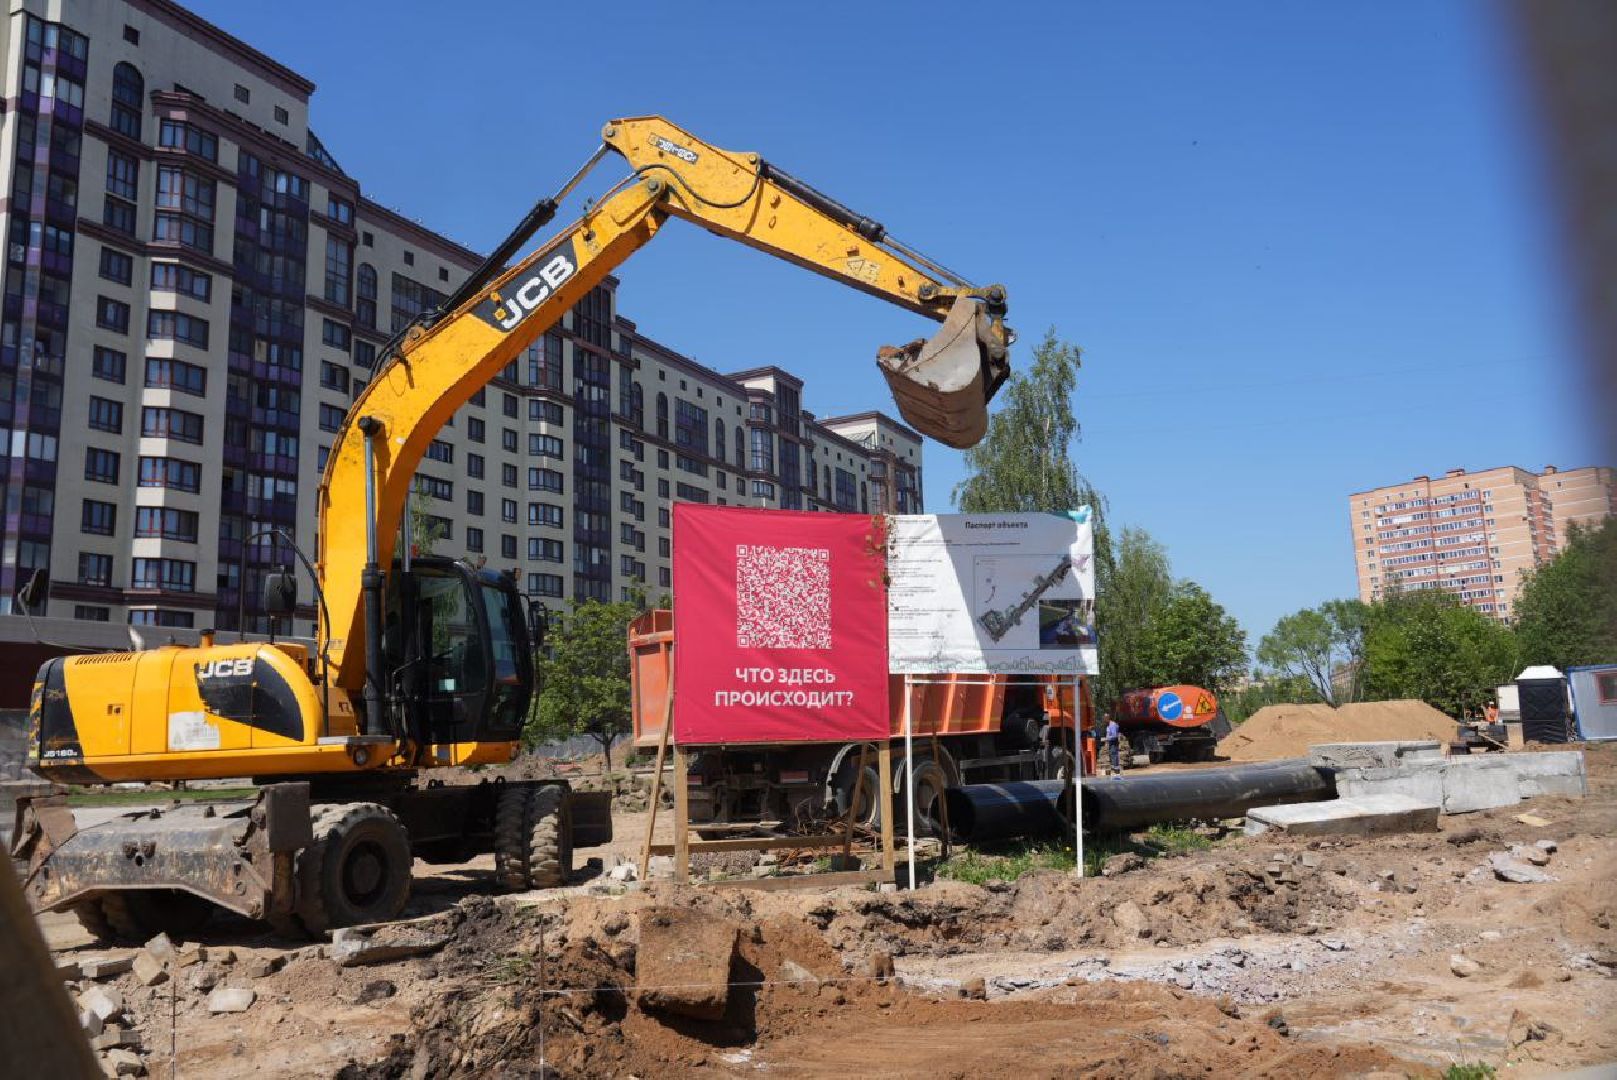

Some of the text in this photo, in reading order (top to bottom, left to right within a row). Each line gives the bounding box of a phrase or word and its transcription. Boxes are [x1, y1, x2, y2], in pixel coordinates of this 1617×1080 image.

[501, 255, 574, 329] JCB
[965, 521, 996, 531] Паспорт
[197, 659, 253, 679] JCB
[735, 667, 836, 685] ЧТО ЗДЕСЬ
[715, 691, 854, 709] ПРОИСХОДИТ?
